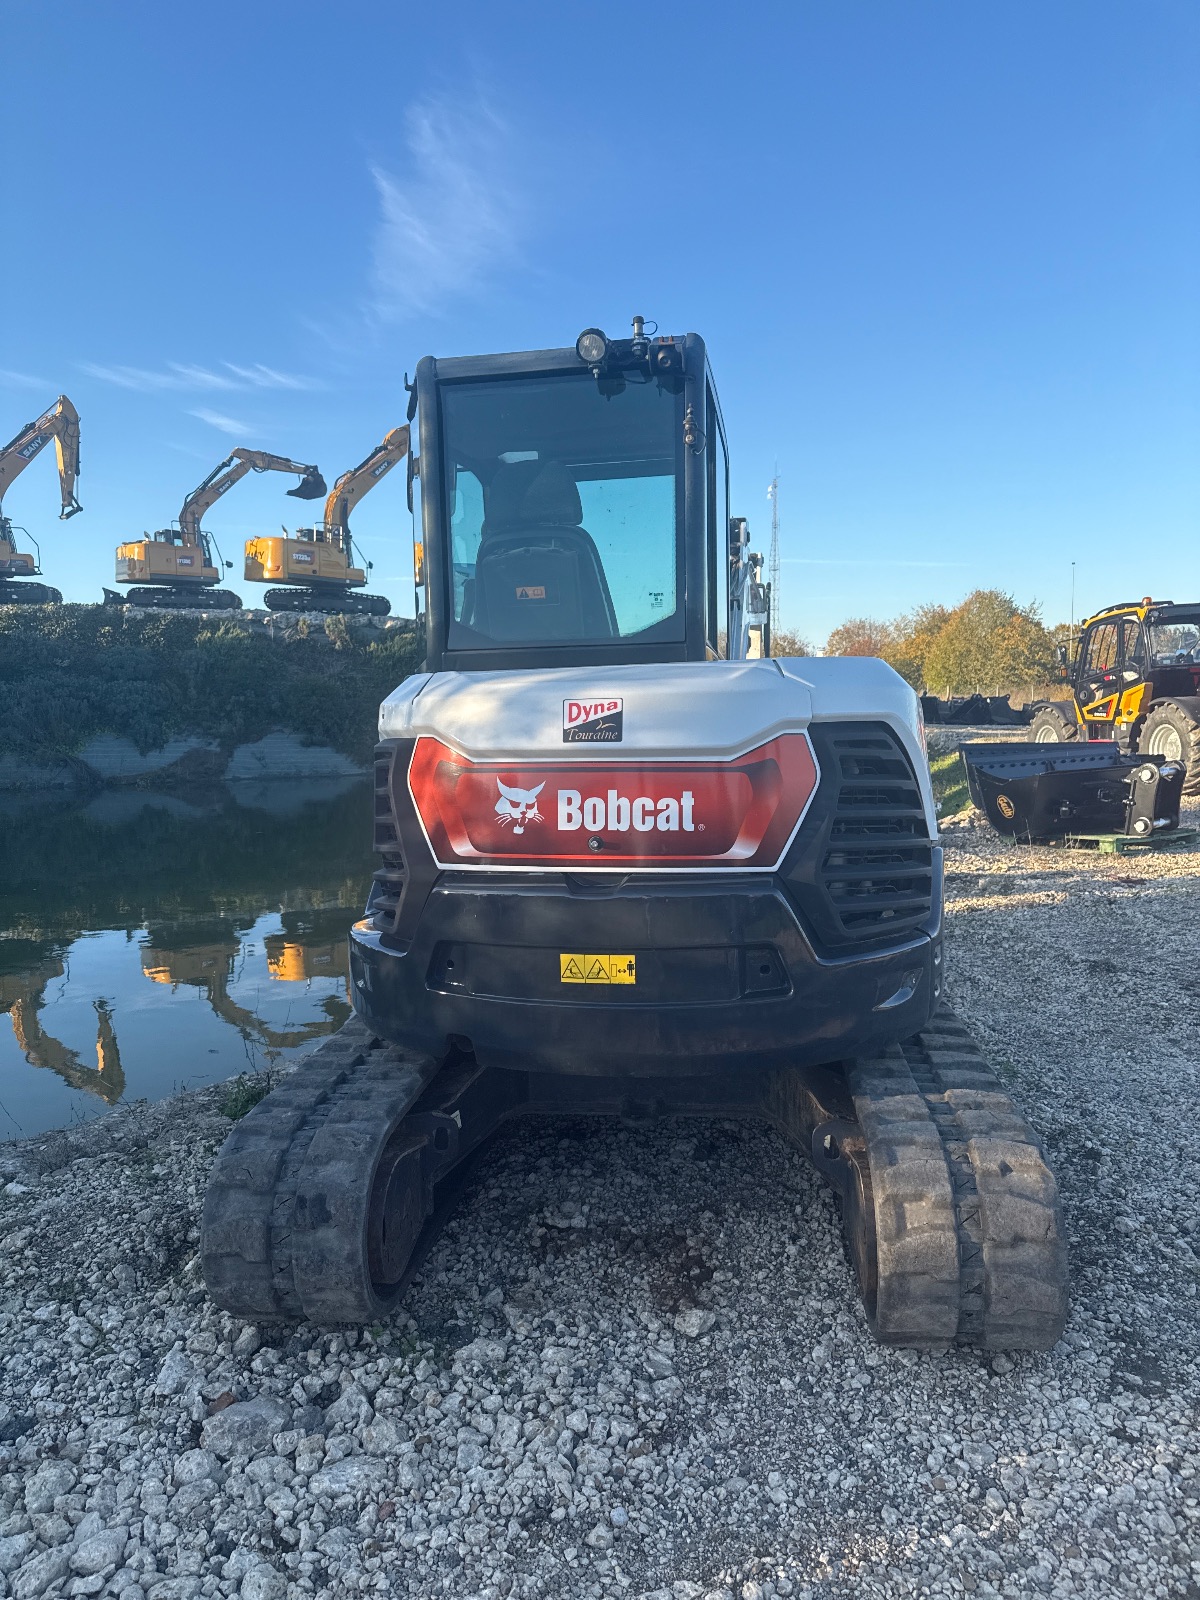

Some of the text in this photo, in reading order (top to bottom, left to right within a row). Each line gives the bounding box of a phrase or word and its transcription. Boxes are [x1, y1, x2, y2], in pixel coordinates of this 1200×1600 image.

[22, 436, 43, 458] SANY
[374, 461, 388, 476] SANY
[219, 479, 231, 493] SANY
[568, 701, 618, 723] Dyna
[566, 728, 618, 741] Touraine
[557, 789, 695, 832] Bobcat
